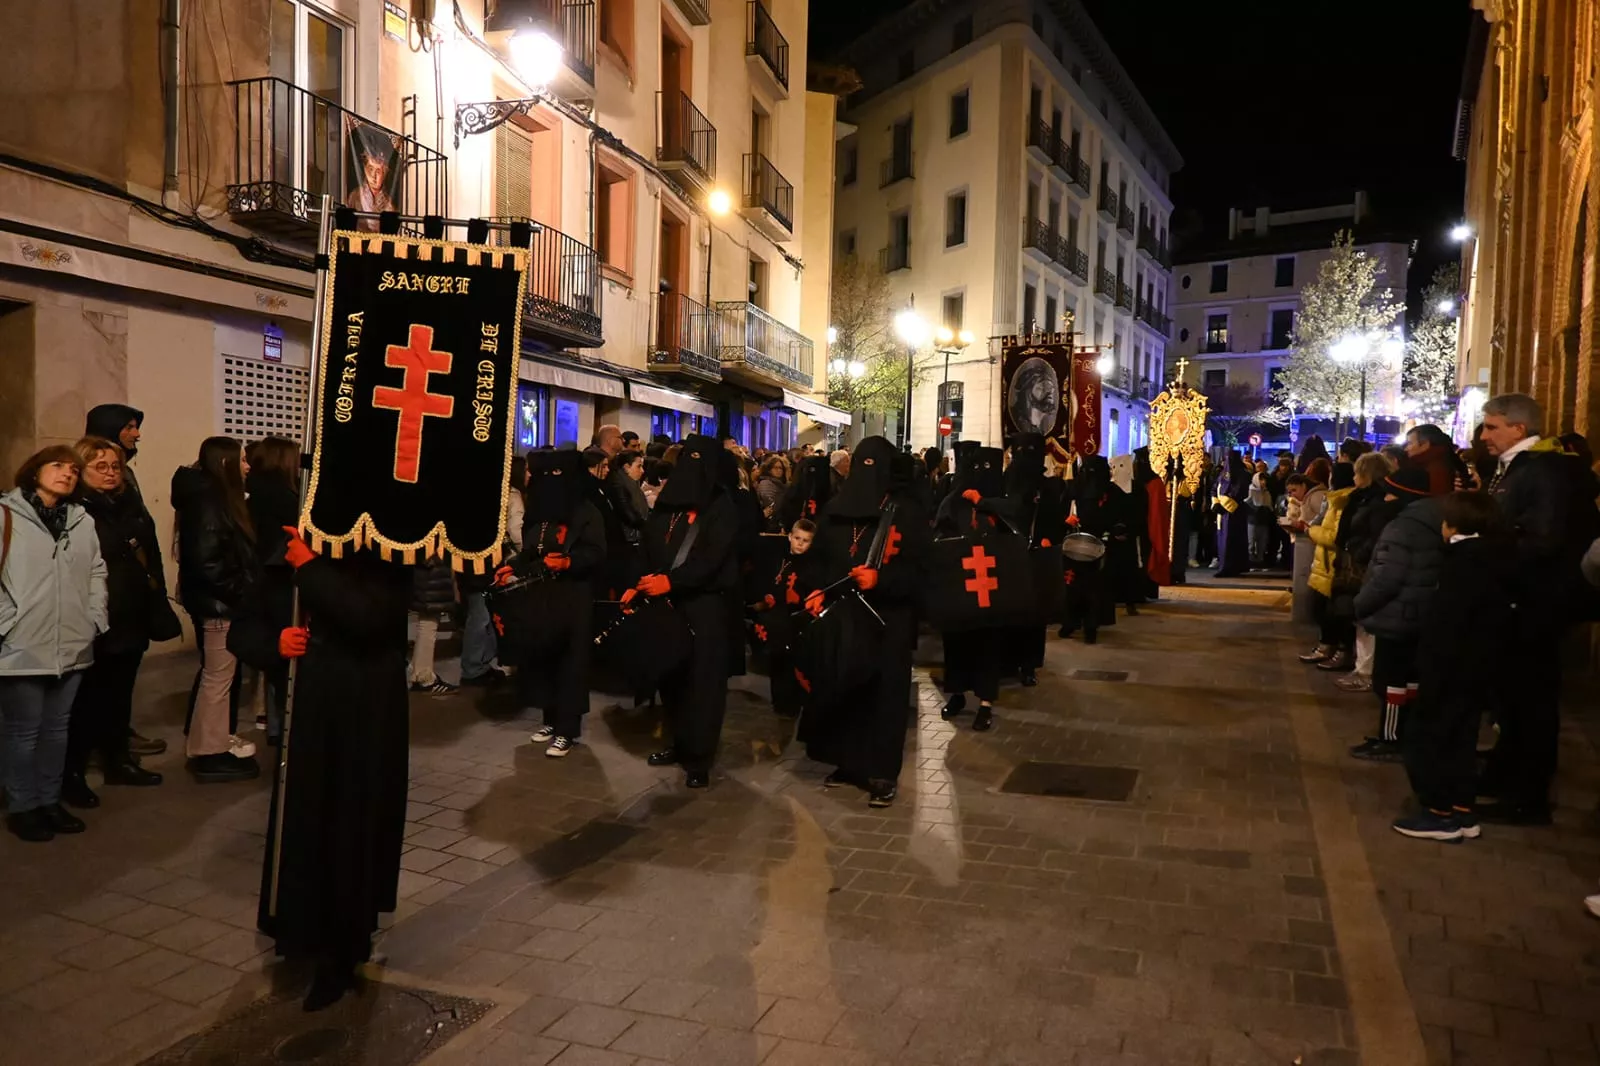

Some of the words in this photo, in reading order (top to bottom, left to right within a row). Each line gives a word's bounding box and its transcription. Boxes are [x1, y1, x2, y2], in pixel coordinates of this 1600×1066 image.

[378, 271, 471, 294] SANGRE
[334, 311, 364, 423] COFRADIA
[480, 321, 499, 355] DE
[472, 360, 495, 442] CRISTO
